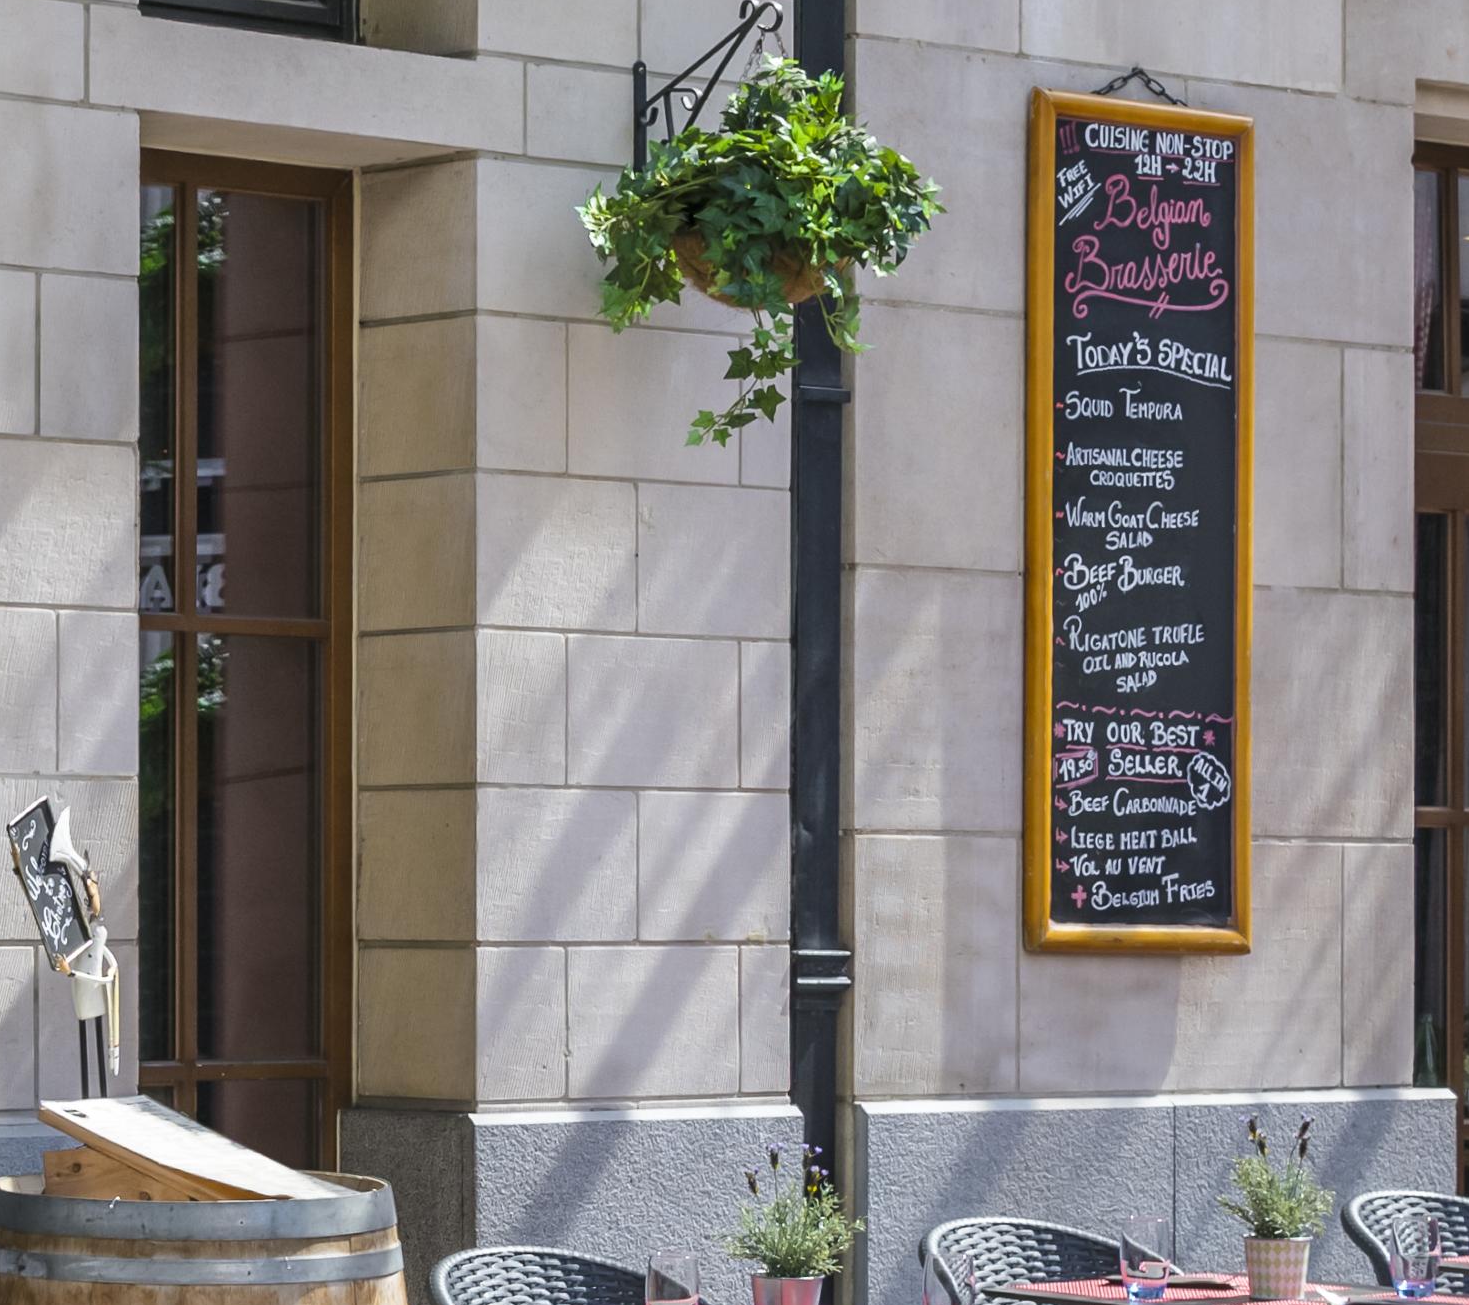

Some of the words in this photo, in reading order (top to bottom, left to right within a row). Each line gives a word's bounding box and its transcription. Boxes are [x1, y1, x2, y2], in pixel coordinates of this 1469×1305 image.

[1084, 122, 1150, 153] CUISINE
[1155, 131, 1234, 161] NON-STOP
[1056, 159, 1089, 188] FREE
[1134, 154, 1162, 177] 12H
[1182, 157, 1218, 184] 22H
[1058, 173, 1096, 209] WIFI
[1094, 173, 1212, 251] Belgian
[1065, 234, 1223, 295] Brasserie
[1066, 330, 1152, 369] TODAY'S
[1158, 336, 1233, 382] SPECIAL
[1064, 389, 1114, 421] SQUID
[1119, 385, 1183, 422] TEMPURA
[1065, 445, 1131, 468] ARTISANAL
[1131, 447, 1184, 469] CHEESE
[1089, 469, 1176, 491] CROQUETTES
[1065, 495, 1106, 528] WARM
[1108, 500, 1145, 529] GOAT
[1146, 500, 1200, 530] CHEESE
[1105, 530, 1154, 551] SALAD
[1063, 552, 1117, 591] BEEF
[1117, 555, 1185, 592] BURGER
[1075, 583, 1108, 613] 100%
[1062, 614, 1148, 653] RIGATONE
[1151, 623, 1206, 646] TRUFLE
[1082, 654, 1111, 675] OIL
[1114, 651, 1137, 671] AND
[1137, 649, 1190, 669] RUCOLA
[1116, 669, 1158, 694] SALAD
[1063, 718, 1095, 744] TRY
[1106, 721, 1145, 746] OUR
[1150, 721, 1200, 747] BEST
[1108, 748, 1183, 777] SELLER
[1193, 757, 1214, 782] ALL
[1212, 771, 1228, 793] IN
[1069, 790, 1110, 817] BEEF
[1113, 787, 1198, 817] CARBONNADE
[1197, 783, 1211, 803] 1
[1070, 825, 1116, 851] LIEGE
[1161, 826, 1198, 849] BALL
[1069, 853, 1100, 877] VOL
[1105, 857, 1122, 876] AU
[1127, 855, 1166, 876] VENT
[1091, 880, 1160, 911] BELGIUM
[1162, 873, 1216, 904] FRIES
